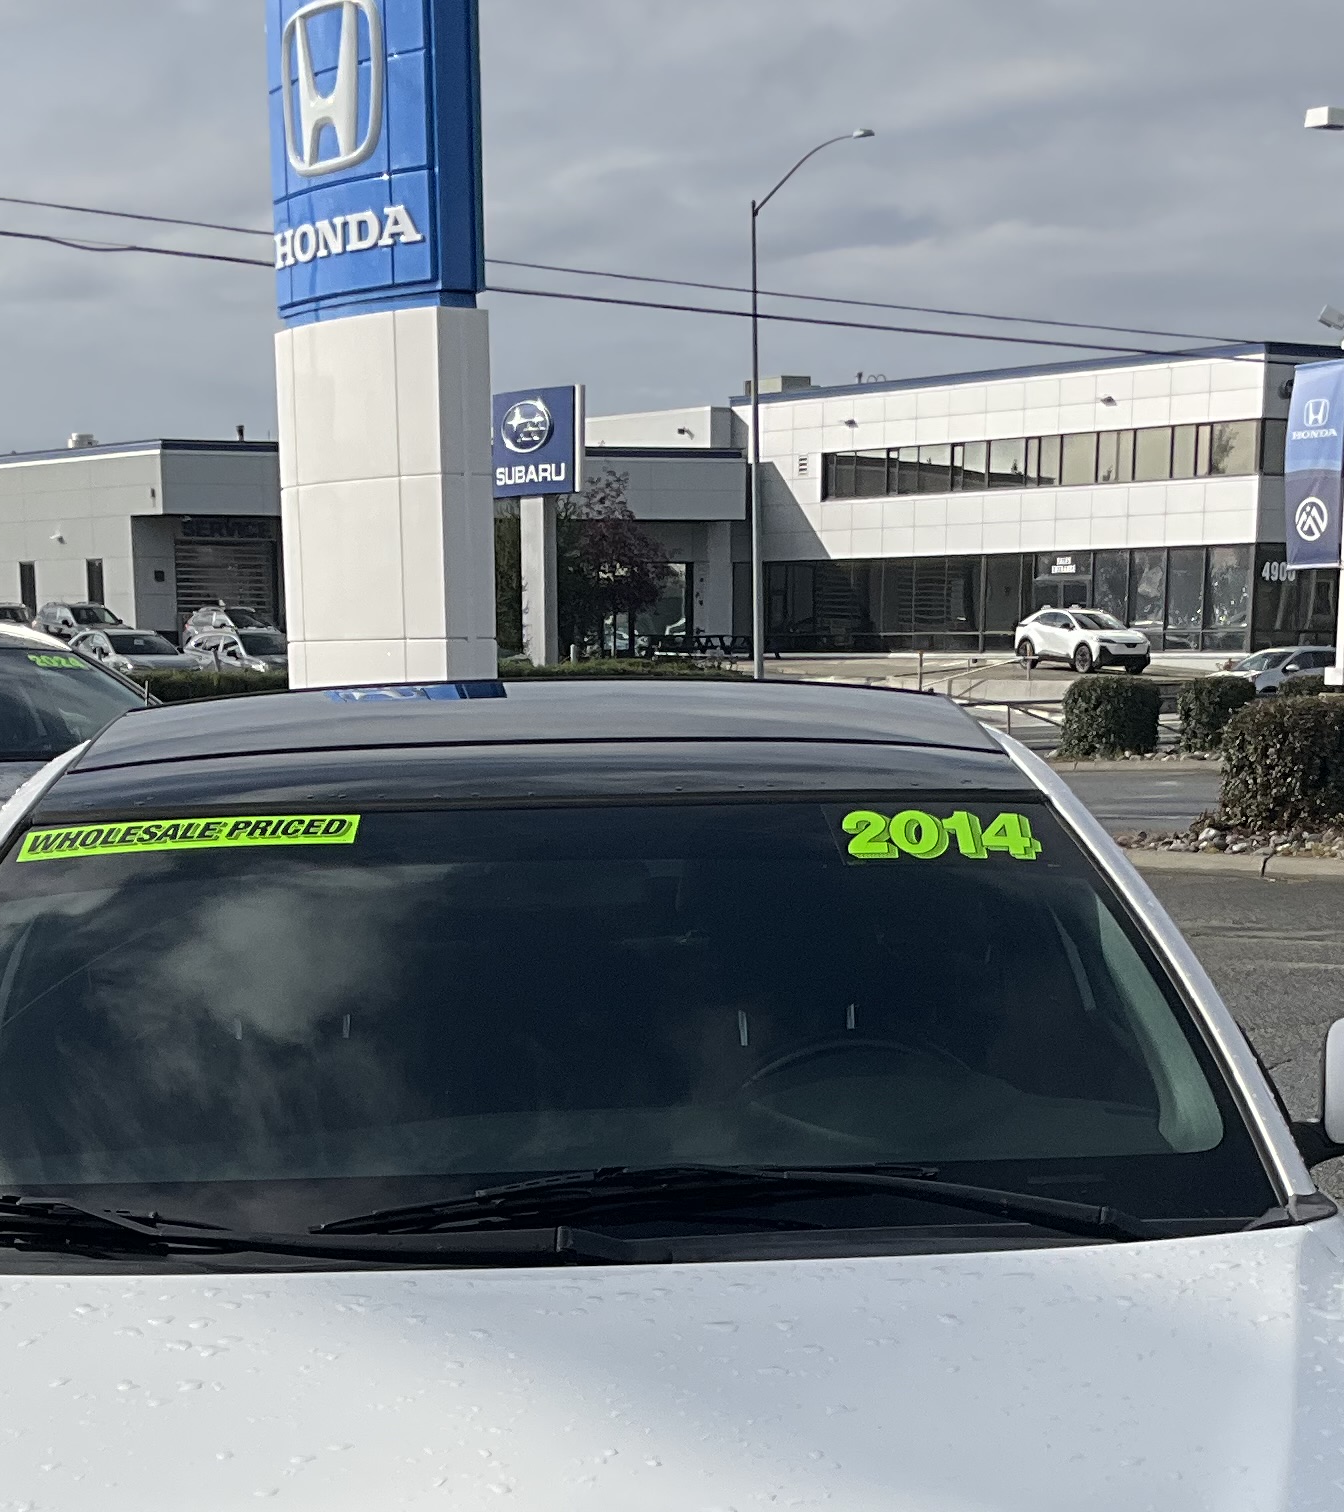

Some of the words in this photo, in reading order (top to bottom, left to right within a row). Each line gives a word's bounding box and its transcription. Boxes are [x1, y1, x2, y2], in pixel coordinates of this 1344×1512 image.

[274, 204, 423, 271] HONDA
[1291, 428, 1338, 441] HONDA
[496, 463, 566, 486] SUBARU
[27, 822, 226, 855] WHOLESALE
[226, 818, 353, 840] PRICED
[842, 809, 1042, 860] 2014
